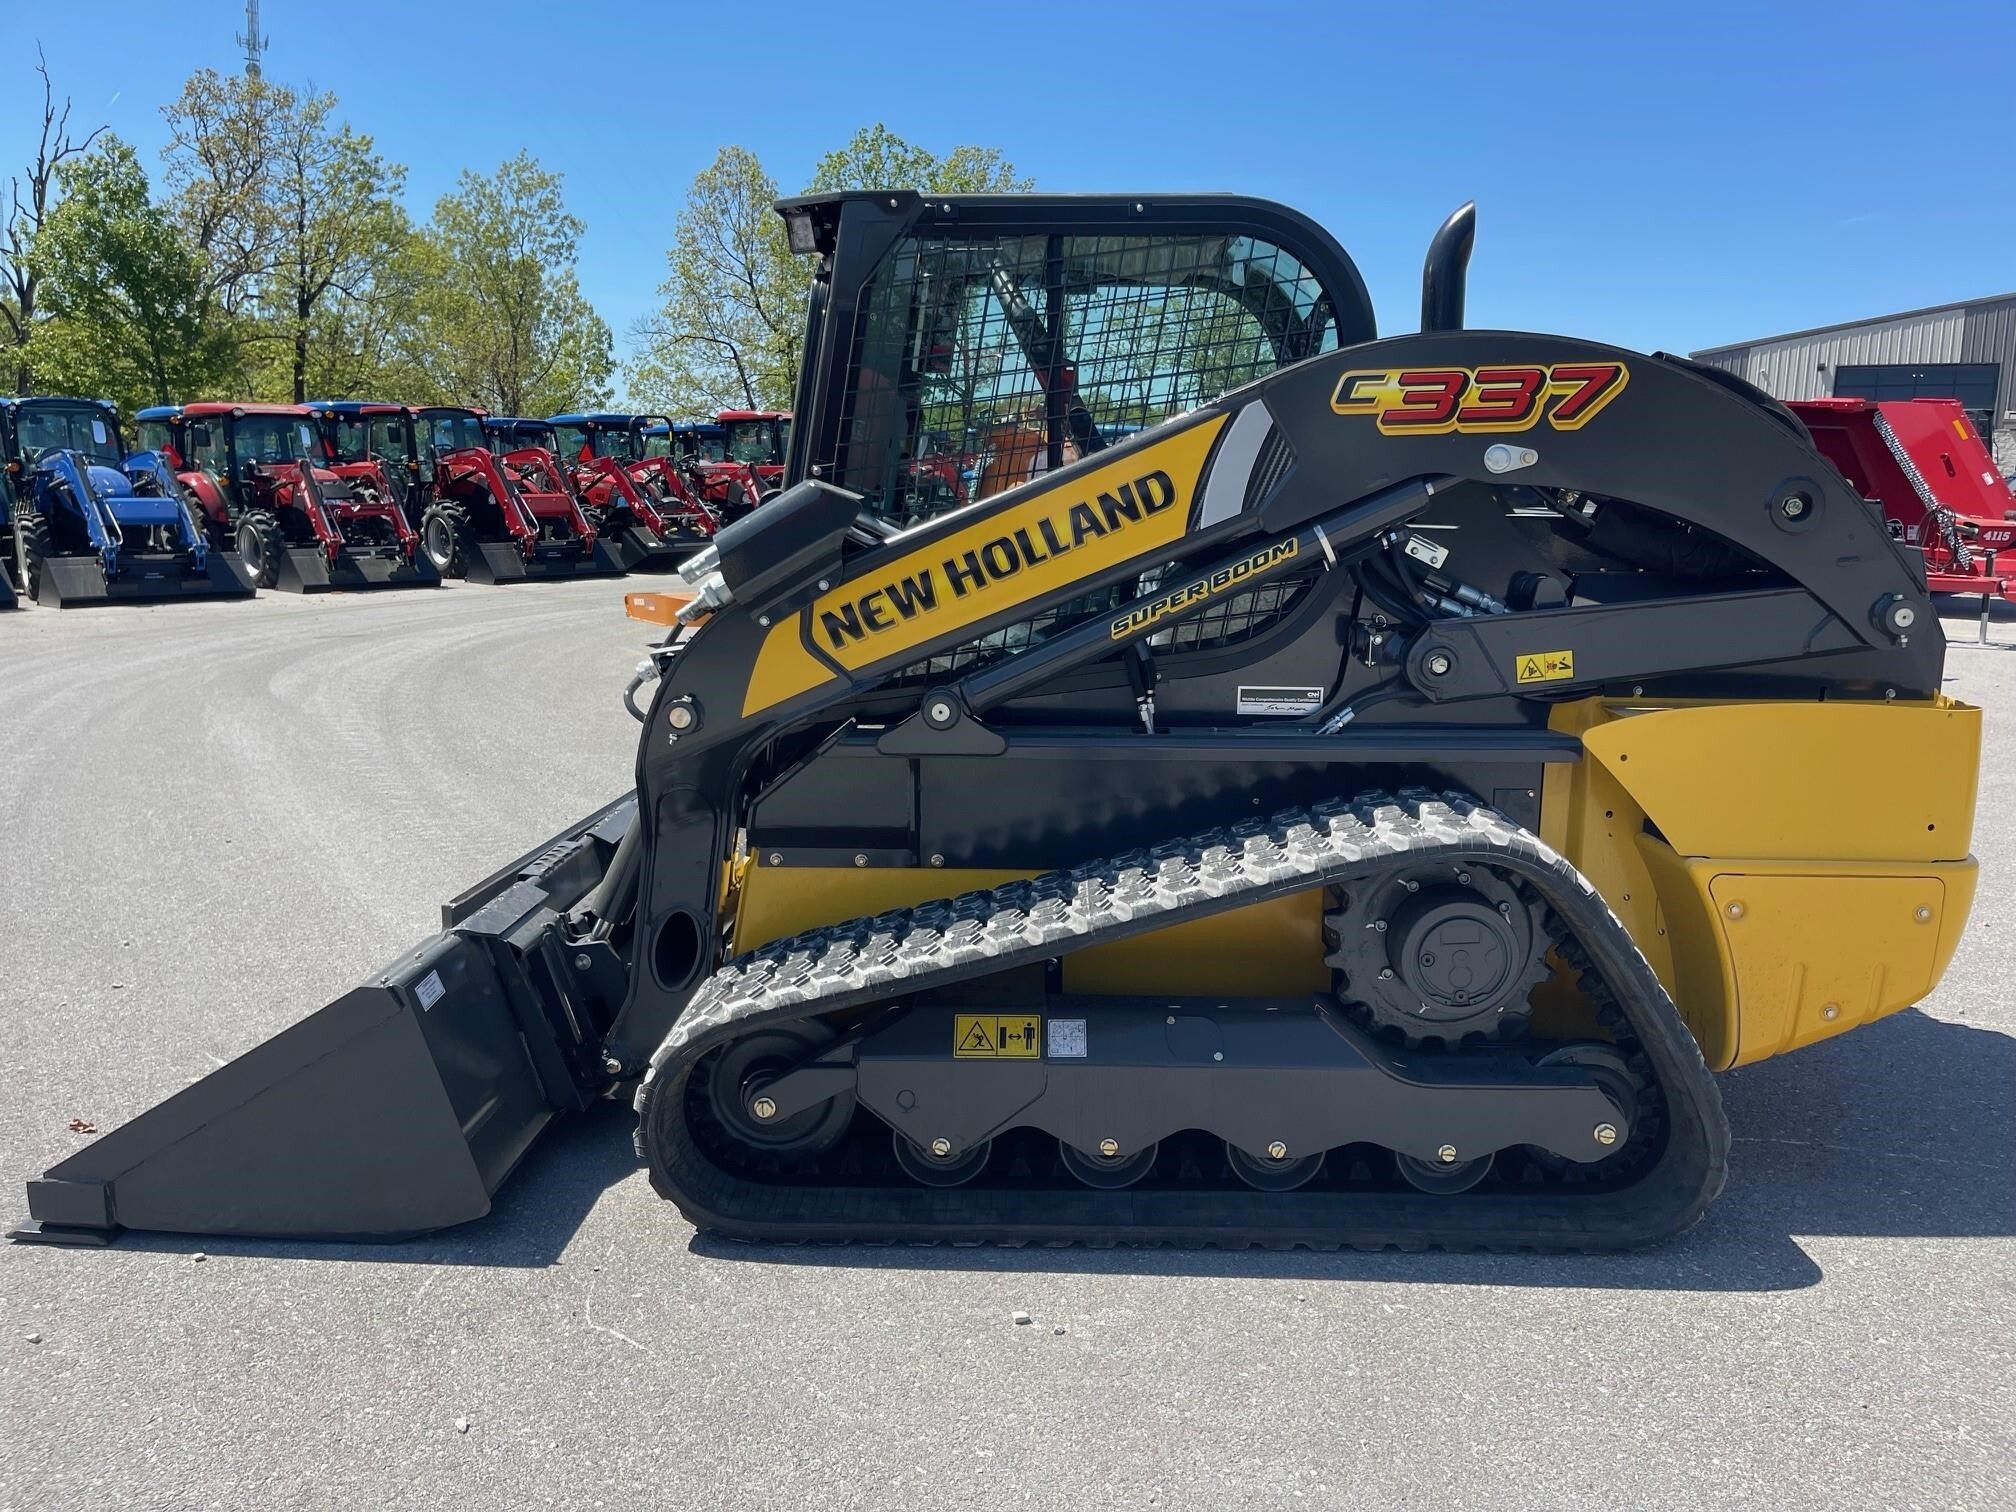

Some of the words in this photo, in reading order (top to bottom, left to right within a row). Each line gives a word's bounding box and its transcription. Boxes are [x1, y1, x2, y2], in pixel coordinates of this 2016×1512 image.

[1331, 362, 1629, 435] C337
[820, 570, 938, 649] NEW
[942, 470, 1177, 597] HOLLAND
[1983, 531, 2011, 540] 4115
[1111, 580, 1208, 640] SUPER
[1211, 537, 1298, 592] BOOM
